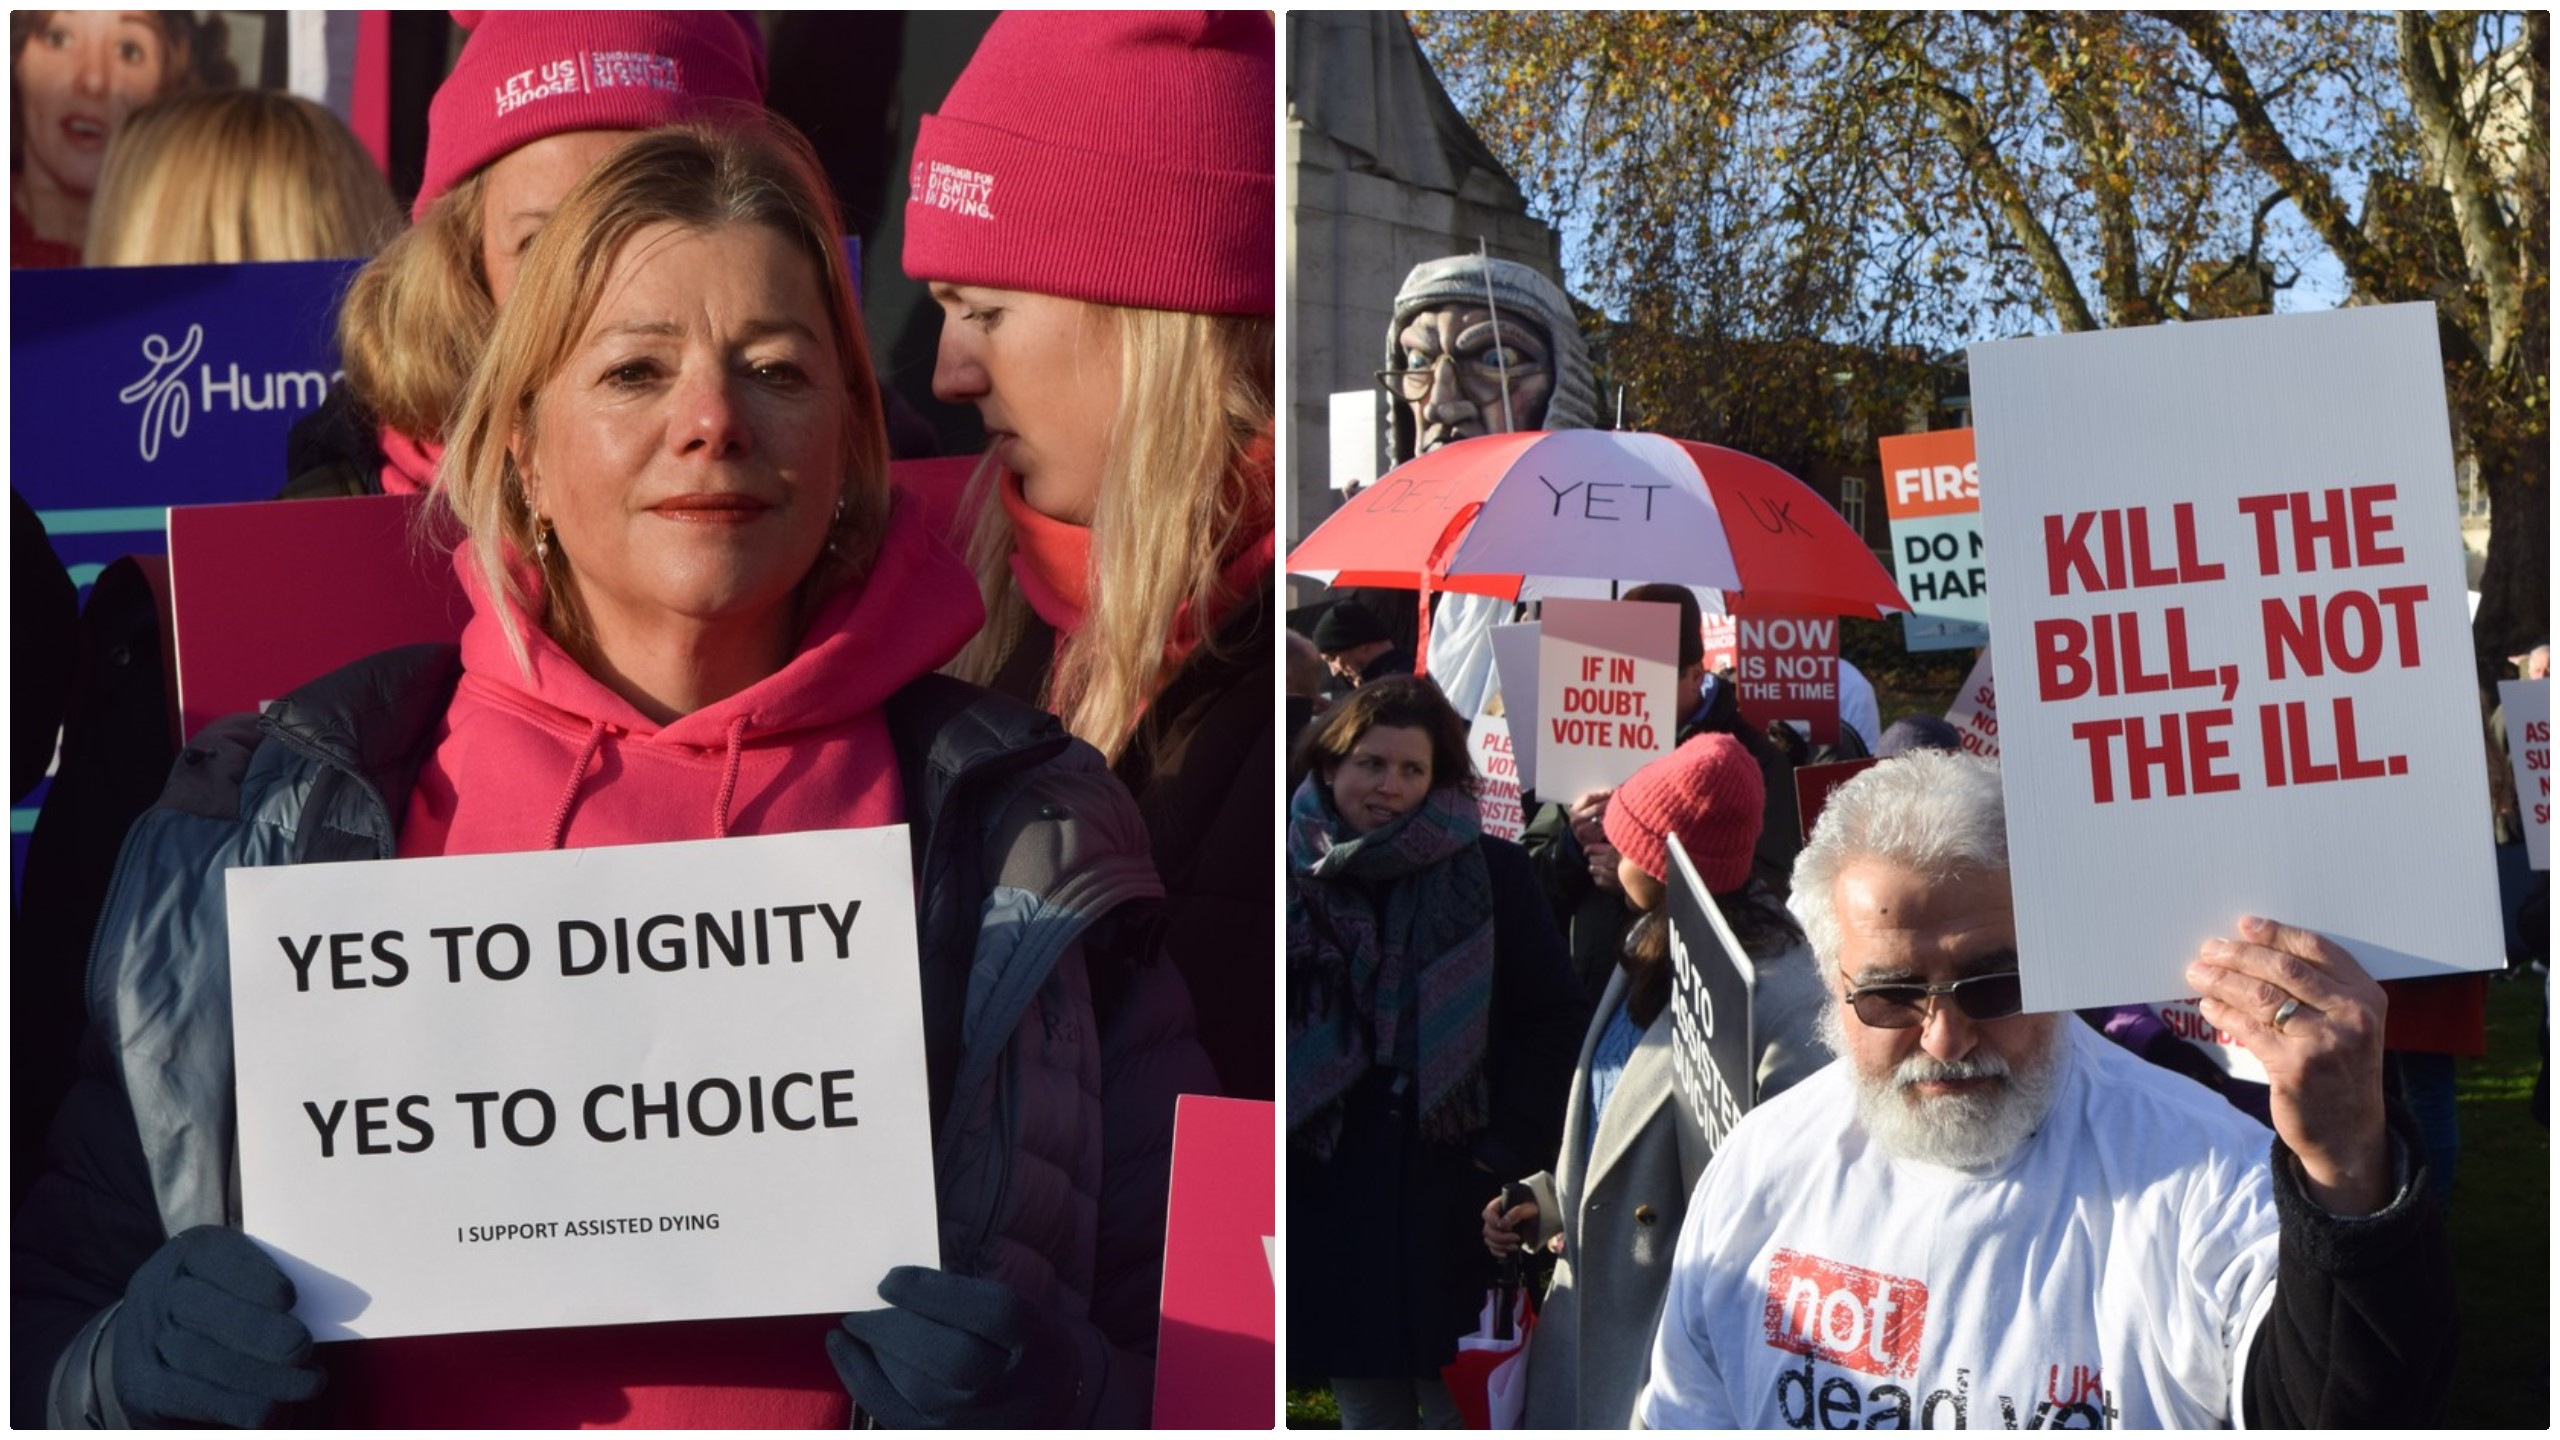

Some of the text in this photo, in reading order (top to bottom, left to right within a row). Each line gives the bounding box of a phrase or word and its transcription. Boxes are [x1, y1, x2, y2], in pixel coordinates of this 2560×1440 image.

[495, 60, 575, 104] LET US
[498, 77, 579, 118] CHOOSE
[929, 173, 993, 204] DIGNITY
[974, 171, 995, 187] FOR
[938, 192, 995, 220] DYING.
[202, 362, 346, 412] Hum
[1539, 475, 1673, 521] YET
[1737, 491, 1814, 538] UK
[1905, 533, 1959, 564] DO
[2043, 483, 2405, 596] KILL THE
[1741, 620, 1833, 650] NOW
[2033, 584, 2429, 702] BILL, NOT
[1582, 656, 1634, 684] IF IN
[1741, 656, 1835, 679] IS NOT
[1564, 687, 1649, 722] DOUBT,
[1741, 683, 1835, 699] THE TIME
[1552, 718, 1659, 750] VOTE NO.
[2072, 697, 2409, 804] THE ILL.
[278, 900, 863, 992] YES TO DIGNITY
[1669, 917, 1713, 1039] NO TO
[303, 1069, 859, 1158] YES TO CHOICE
[457, 1213, 720, 1242] I SUPPORT ASSISTED DYING
[1782, 1274, 1898, 1363] not
[2047, 1363, 2105, 1409] UK
